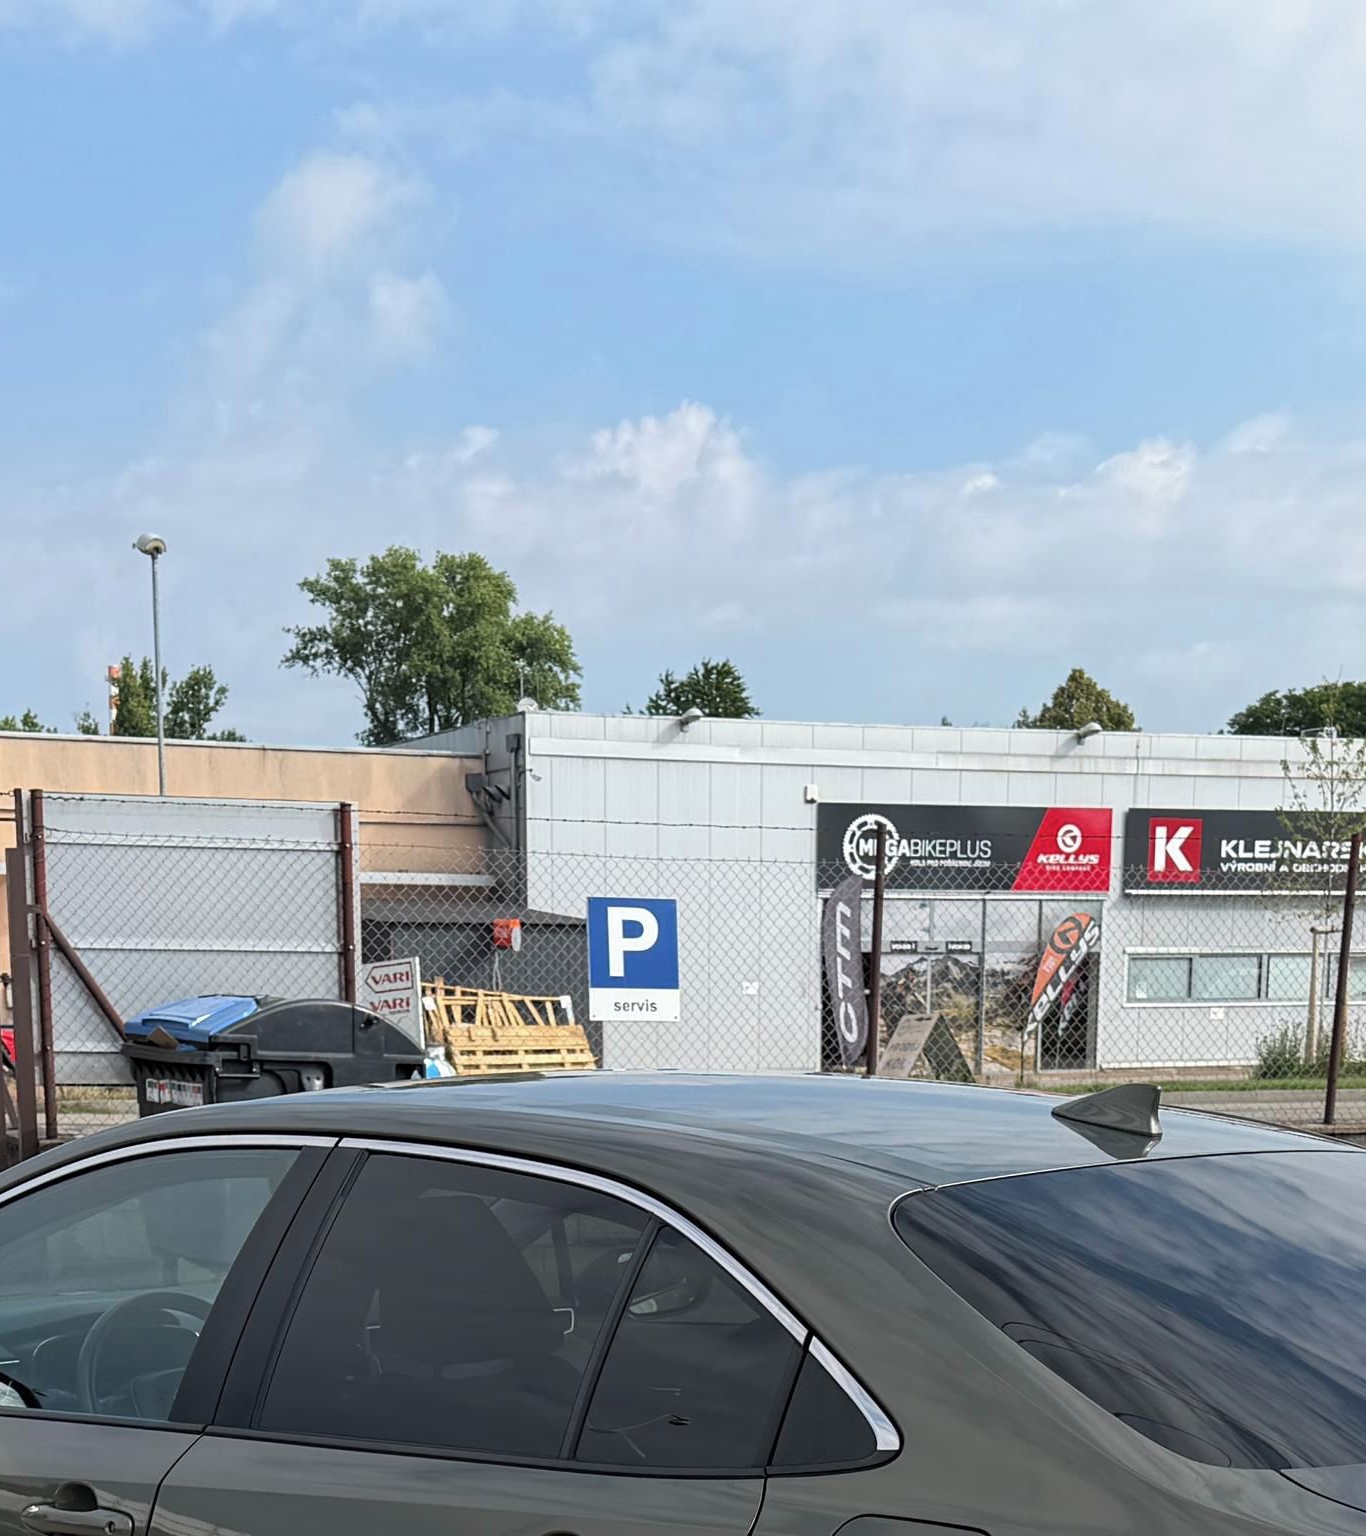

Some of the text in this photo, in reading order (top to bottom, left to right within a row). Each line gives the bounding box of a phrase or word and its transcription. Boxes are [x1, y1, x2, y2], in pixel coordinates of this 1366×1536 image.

[858, 838, 992, 858] MGABIKEPLUS
[1154, 826, 1194, 872] K
[1221, 860, 1277, 873] VÝROBNÍ
[1278, 863, 1289, 873] A
[606, 906, 659, 977] P
[371, 971, 410, 985] VARI
[369, 997, 411, 1012] VARI
[613, 999, 658, 1012] servis
